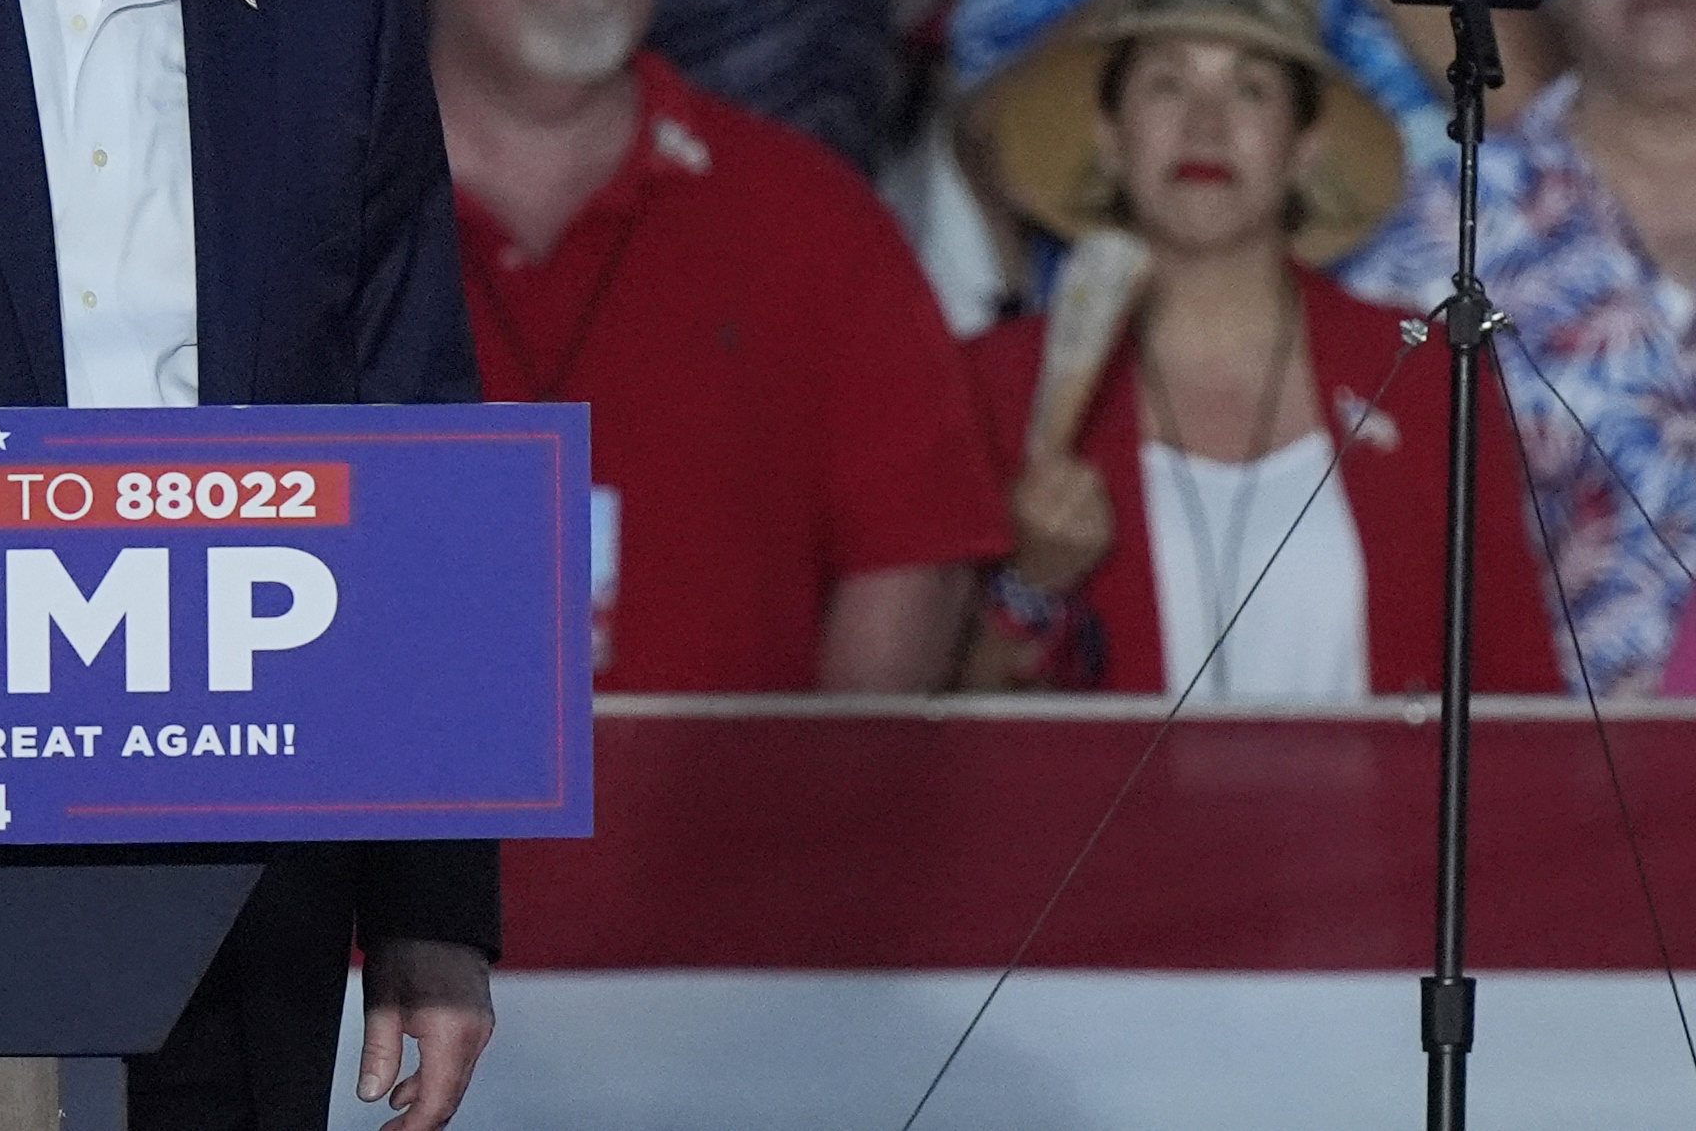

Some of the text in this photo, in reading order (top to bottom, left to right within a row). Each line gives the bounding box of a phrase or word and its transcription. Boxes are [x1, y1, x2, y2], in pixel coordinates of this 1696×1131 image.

[7, 473, 94, 522] TO
[115, 471, 316, 519] 88022
[121, 723, 295, 757] AGAIN!
